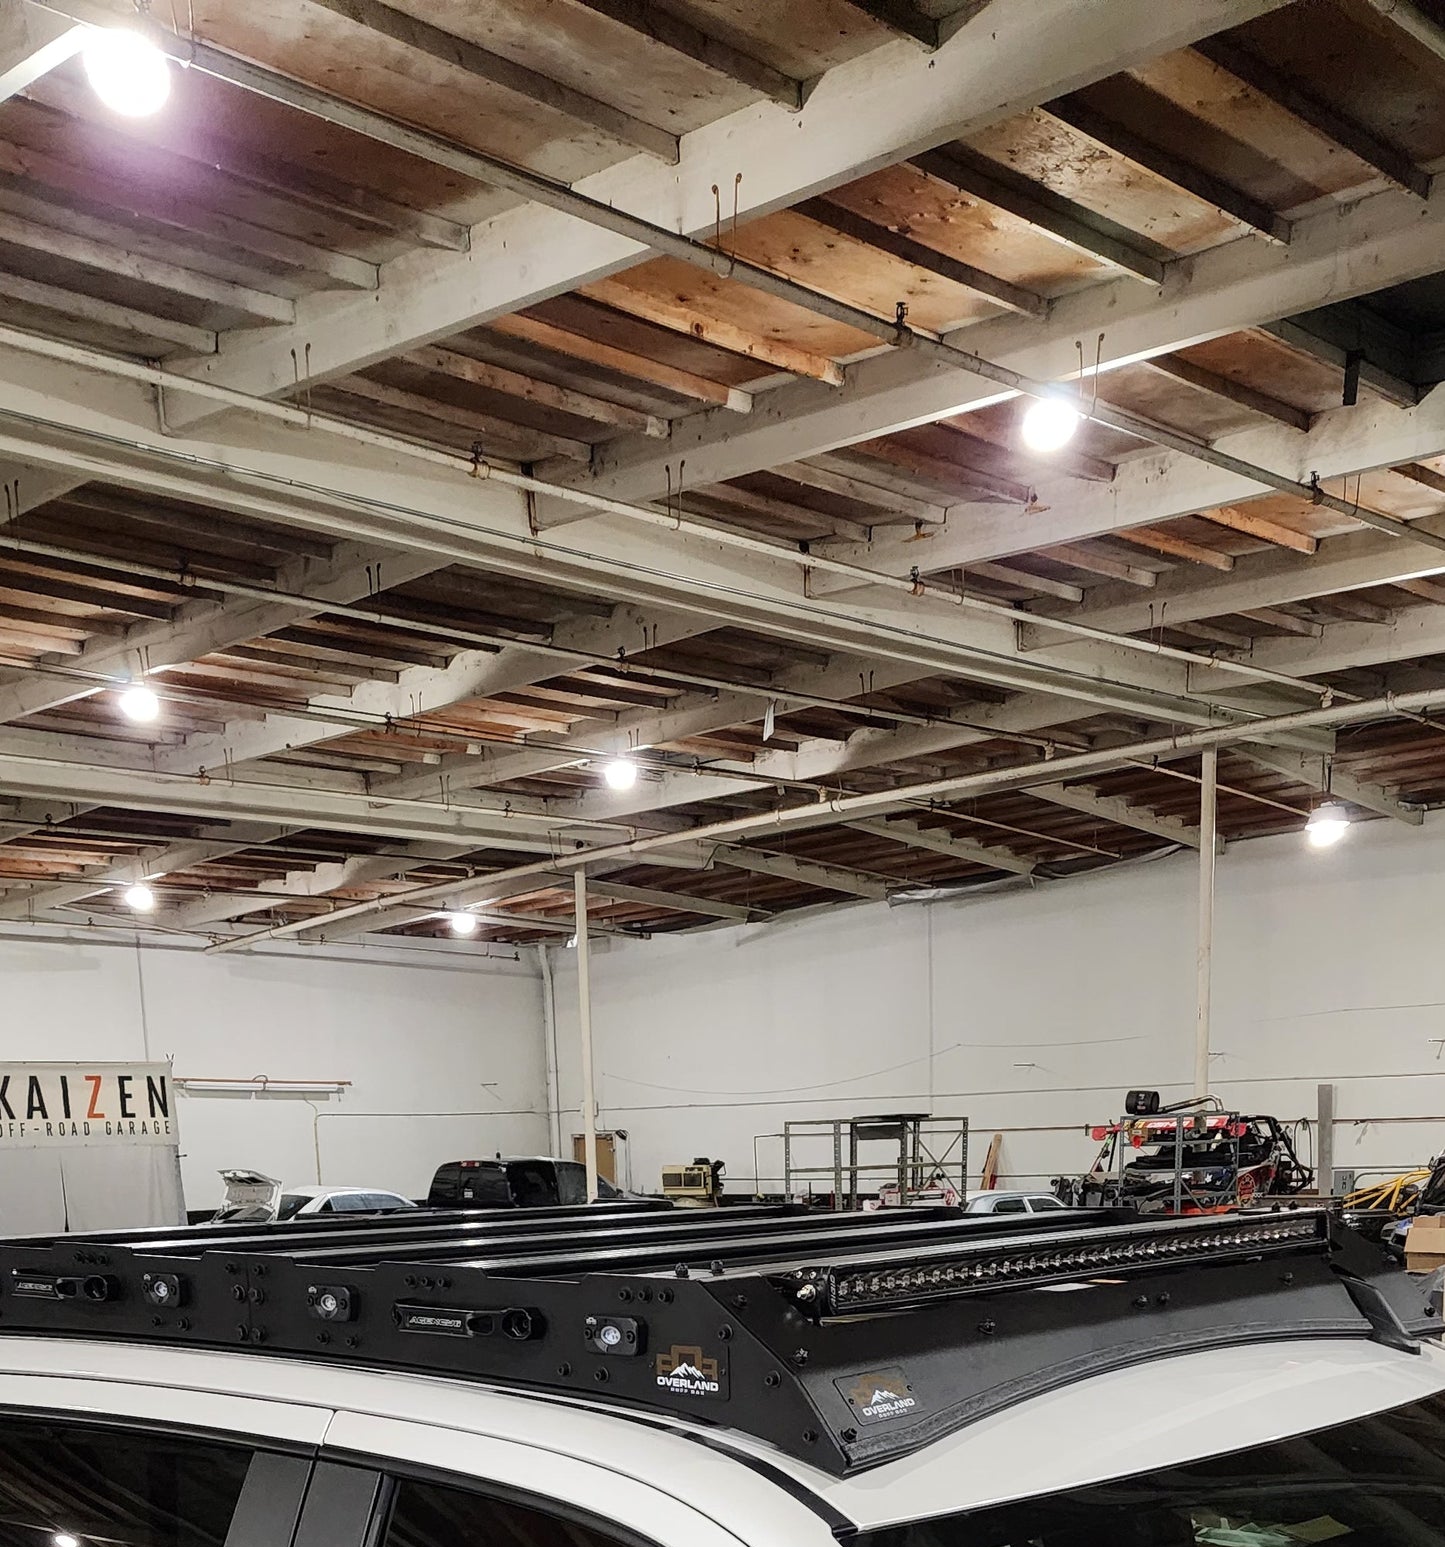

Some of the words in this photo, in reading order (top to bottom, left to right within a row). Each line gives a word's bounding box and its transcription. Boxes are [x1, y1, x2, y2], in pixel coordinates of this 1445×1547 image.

[0, 1075, 169, 1119] KAIZEN
[105, 1120, 171, 1136] GARAGE
[657, 1376, 719, 1392] OVERLAND
[862, 1398, 915, 1416] OVERLAND
